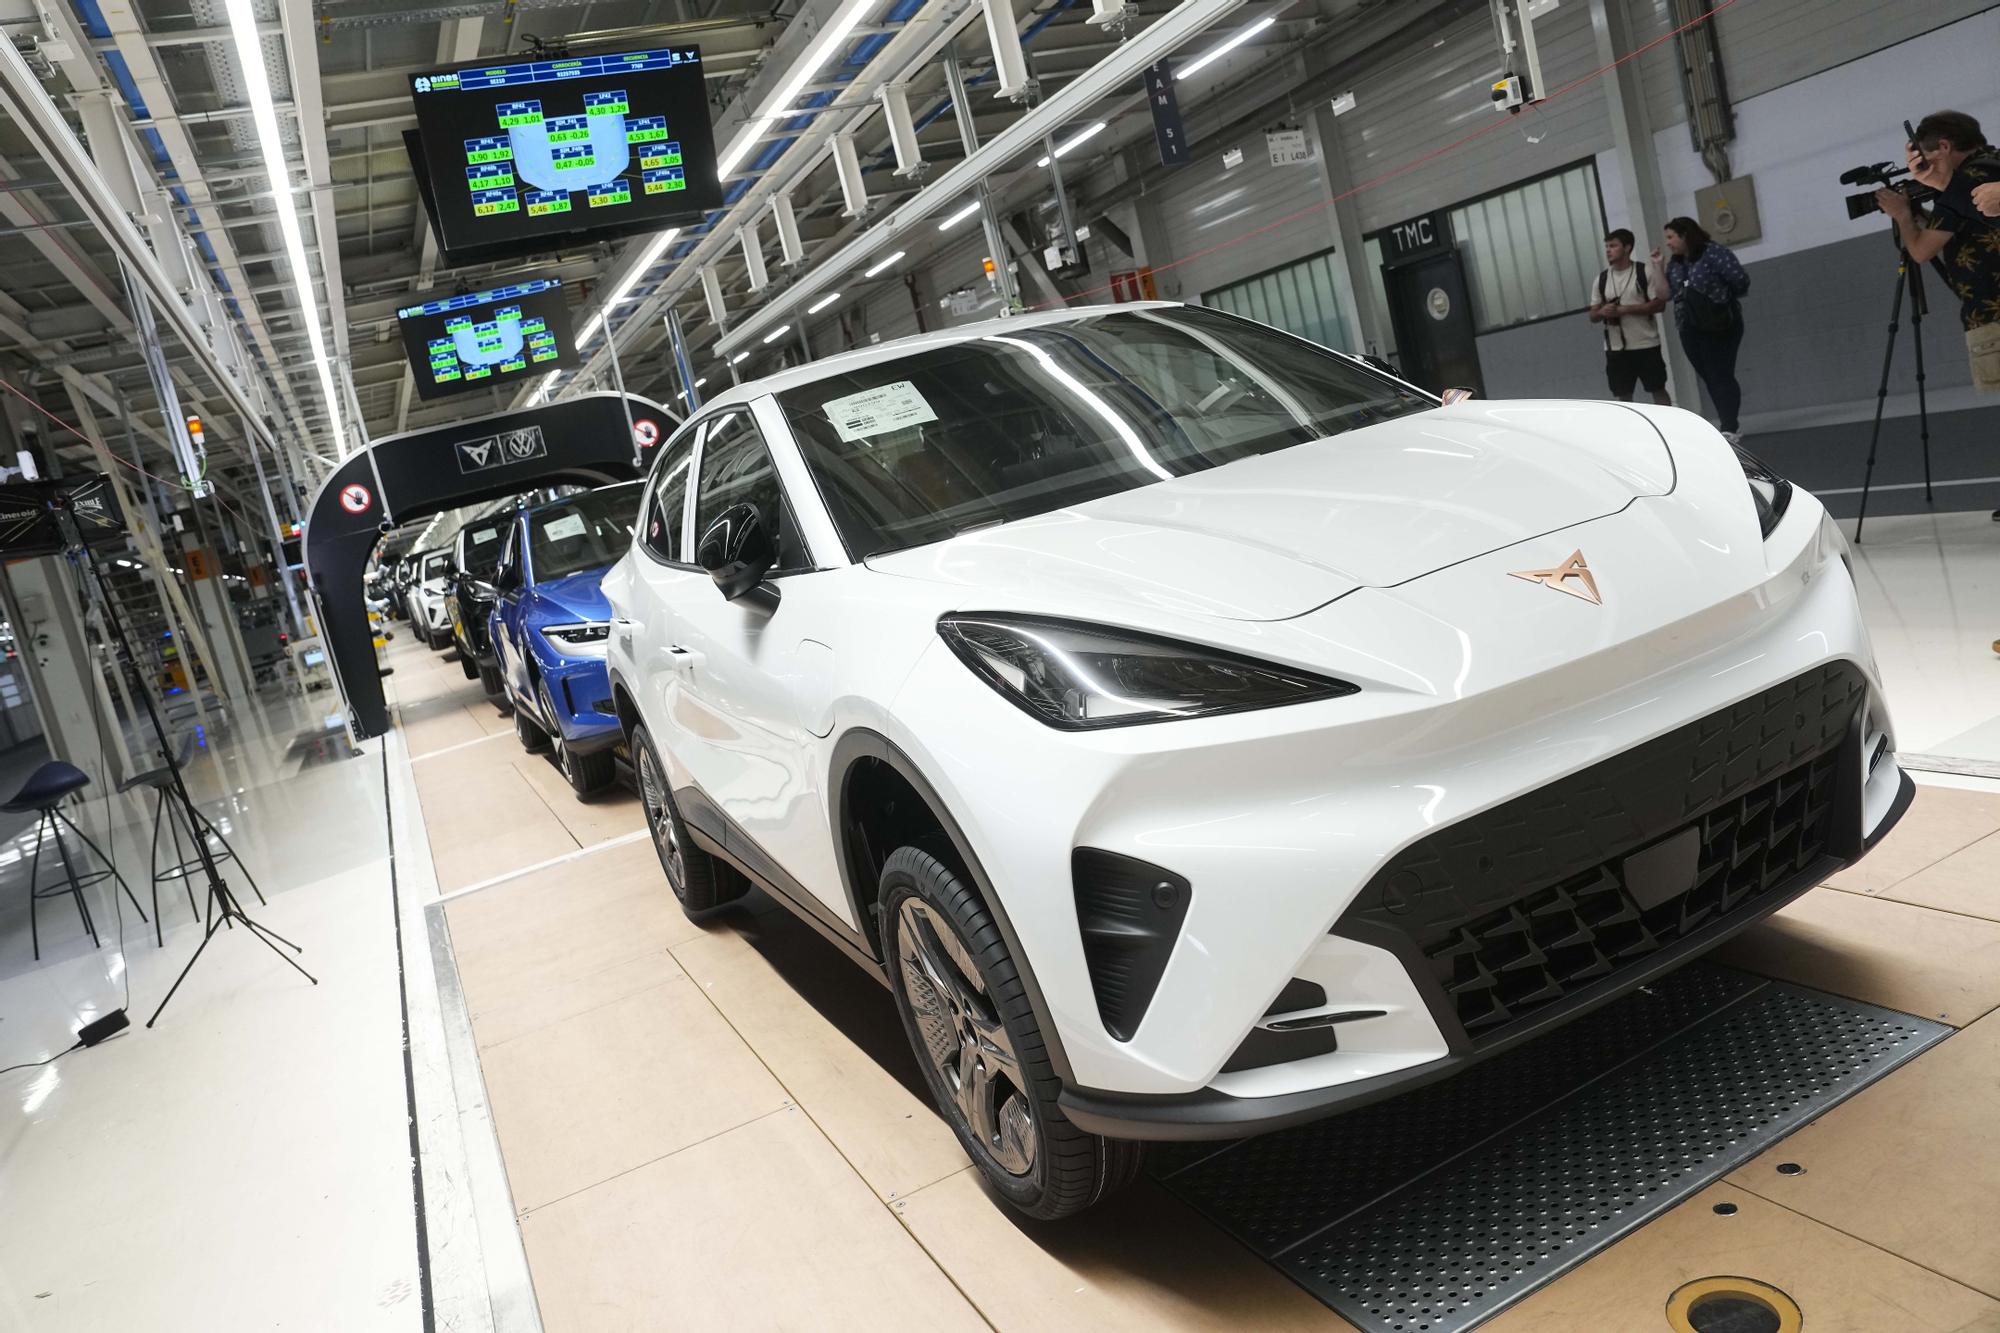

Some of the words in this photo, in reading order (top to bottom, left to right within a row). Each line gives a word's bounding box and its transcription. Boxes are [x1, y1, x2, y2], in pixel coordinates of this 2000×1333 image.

[589, 106, 605, 117] 4,30
[611, 105, 626, 114] 1,29
[502, 115, 519, 126] 4,29
[524, 114, 540, 124] 1,01
[550, 133, 566, 142] 0,63
[570, 131, 589, 139] -0,26
[629, 133, 645, 141] 4,53
[649, 130, 664, 139] 1,67
[471, 154, 488, 162] 3,90
[493, 151, 509, 159] 1,92
[644, 158, 659, 166] 4,65
[556, 161, 572, 170] 0,47
[576, 158, 594, 166] -0,05
[473, 180, 489, 188] 4,17
[495, 177, 510, 185] 1,10
[648, 184, 663, 192] 5,44
[592, 196, 608, 205] 5,30
[612, 193, 628, 202] 1,86
[478, 206, 494, 214] 6,12
[500, 202, 515, 211] 2,47
[531, 206, 547, 214] 5,46
[552, 203, 568, 211] 1,87
[1392, 218, 1433, 252] TMC
